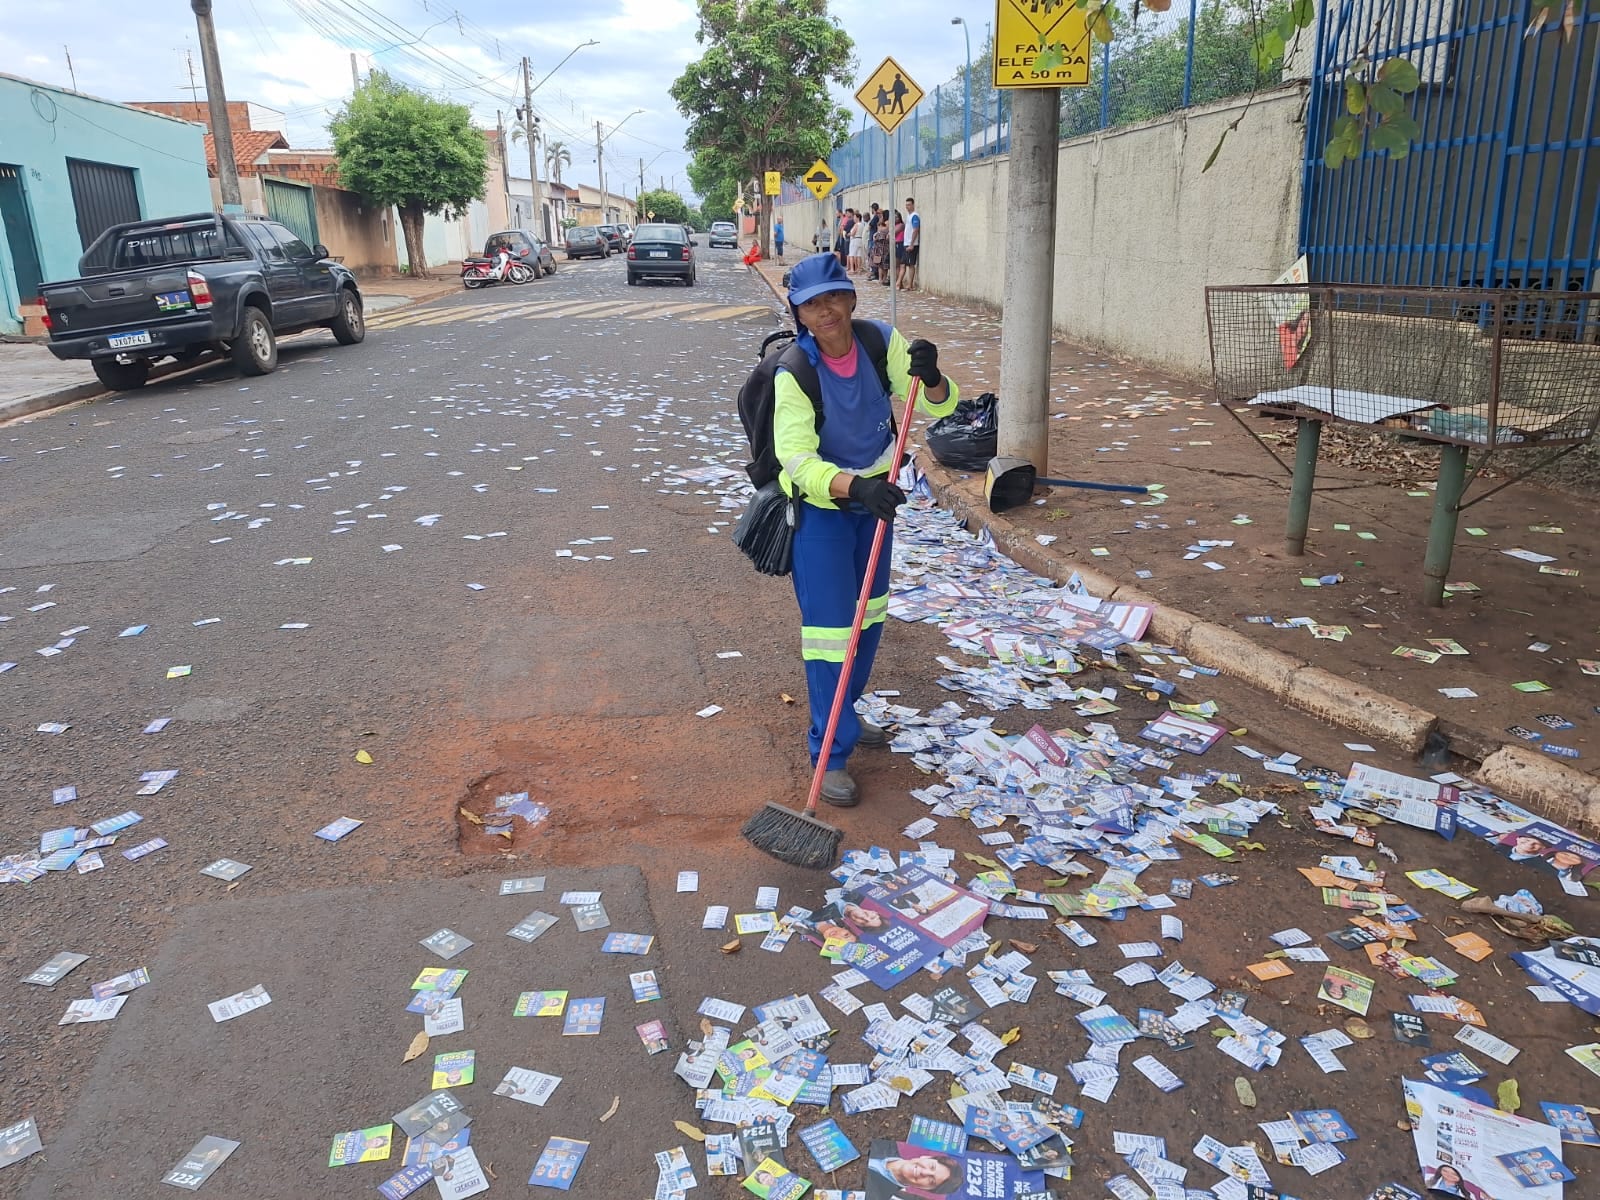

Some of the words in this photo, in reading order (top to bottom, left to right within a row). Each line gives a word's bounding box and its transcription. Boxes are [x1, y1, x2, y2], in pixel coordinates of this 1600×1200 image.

[1015, 43, 1069, 53] FAIXA
[999, 56, 1086, 67] ELEDA
[1012, 70, 1024, 79] A
[1030, 69, 1050, 79] 50
[878, 926, 907, 943] 1234
[934, 987, 956, 1002] 1234
[1551, 978, 1589, 1001] 1234
[434, 1093, 459, 1113] 1234
[743, 1125, 773, 1138] 1234
[334, 1137, 347, 1160] 5569
[168, 1172, 202, 1186] 1234
[967, 1158, 983, 1198] 1234
[986, 1160, 996, 1199] OLIVEIRA
[995, 1160, 1005, 1199] RAPHAEL
